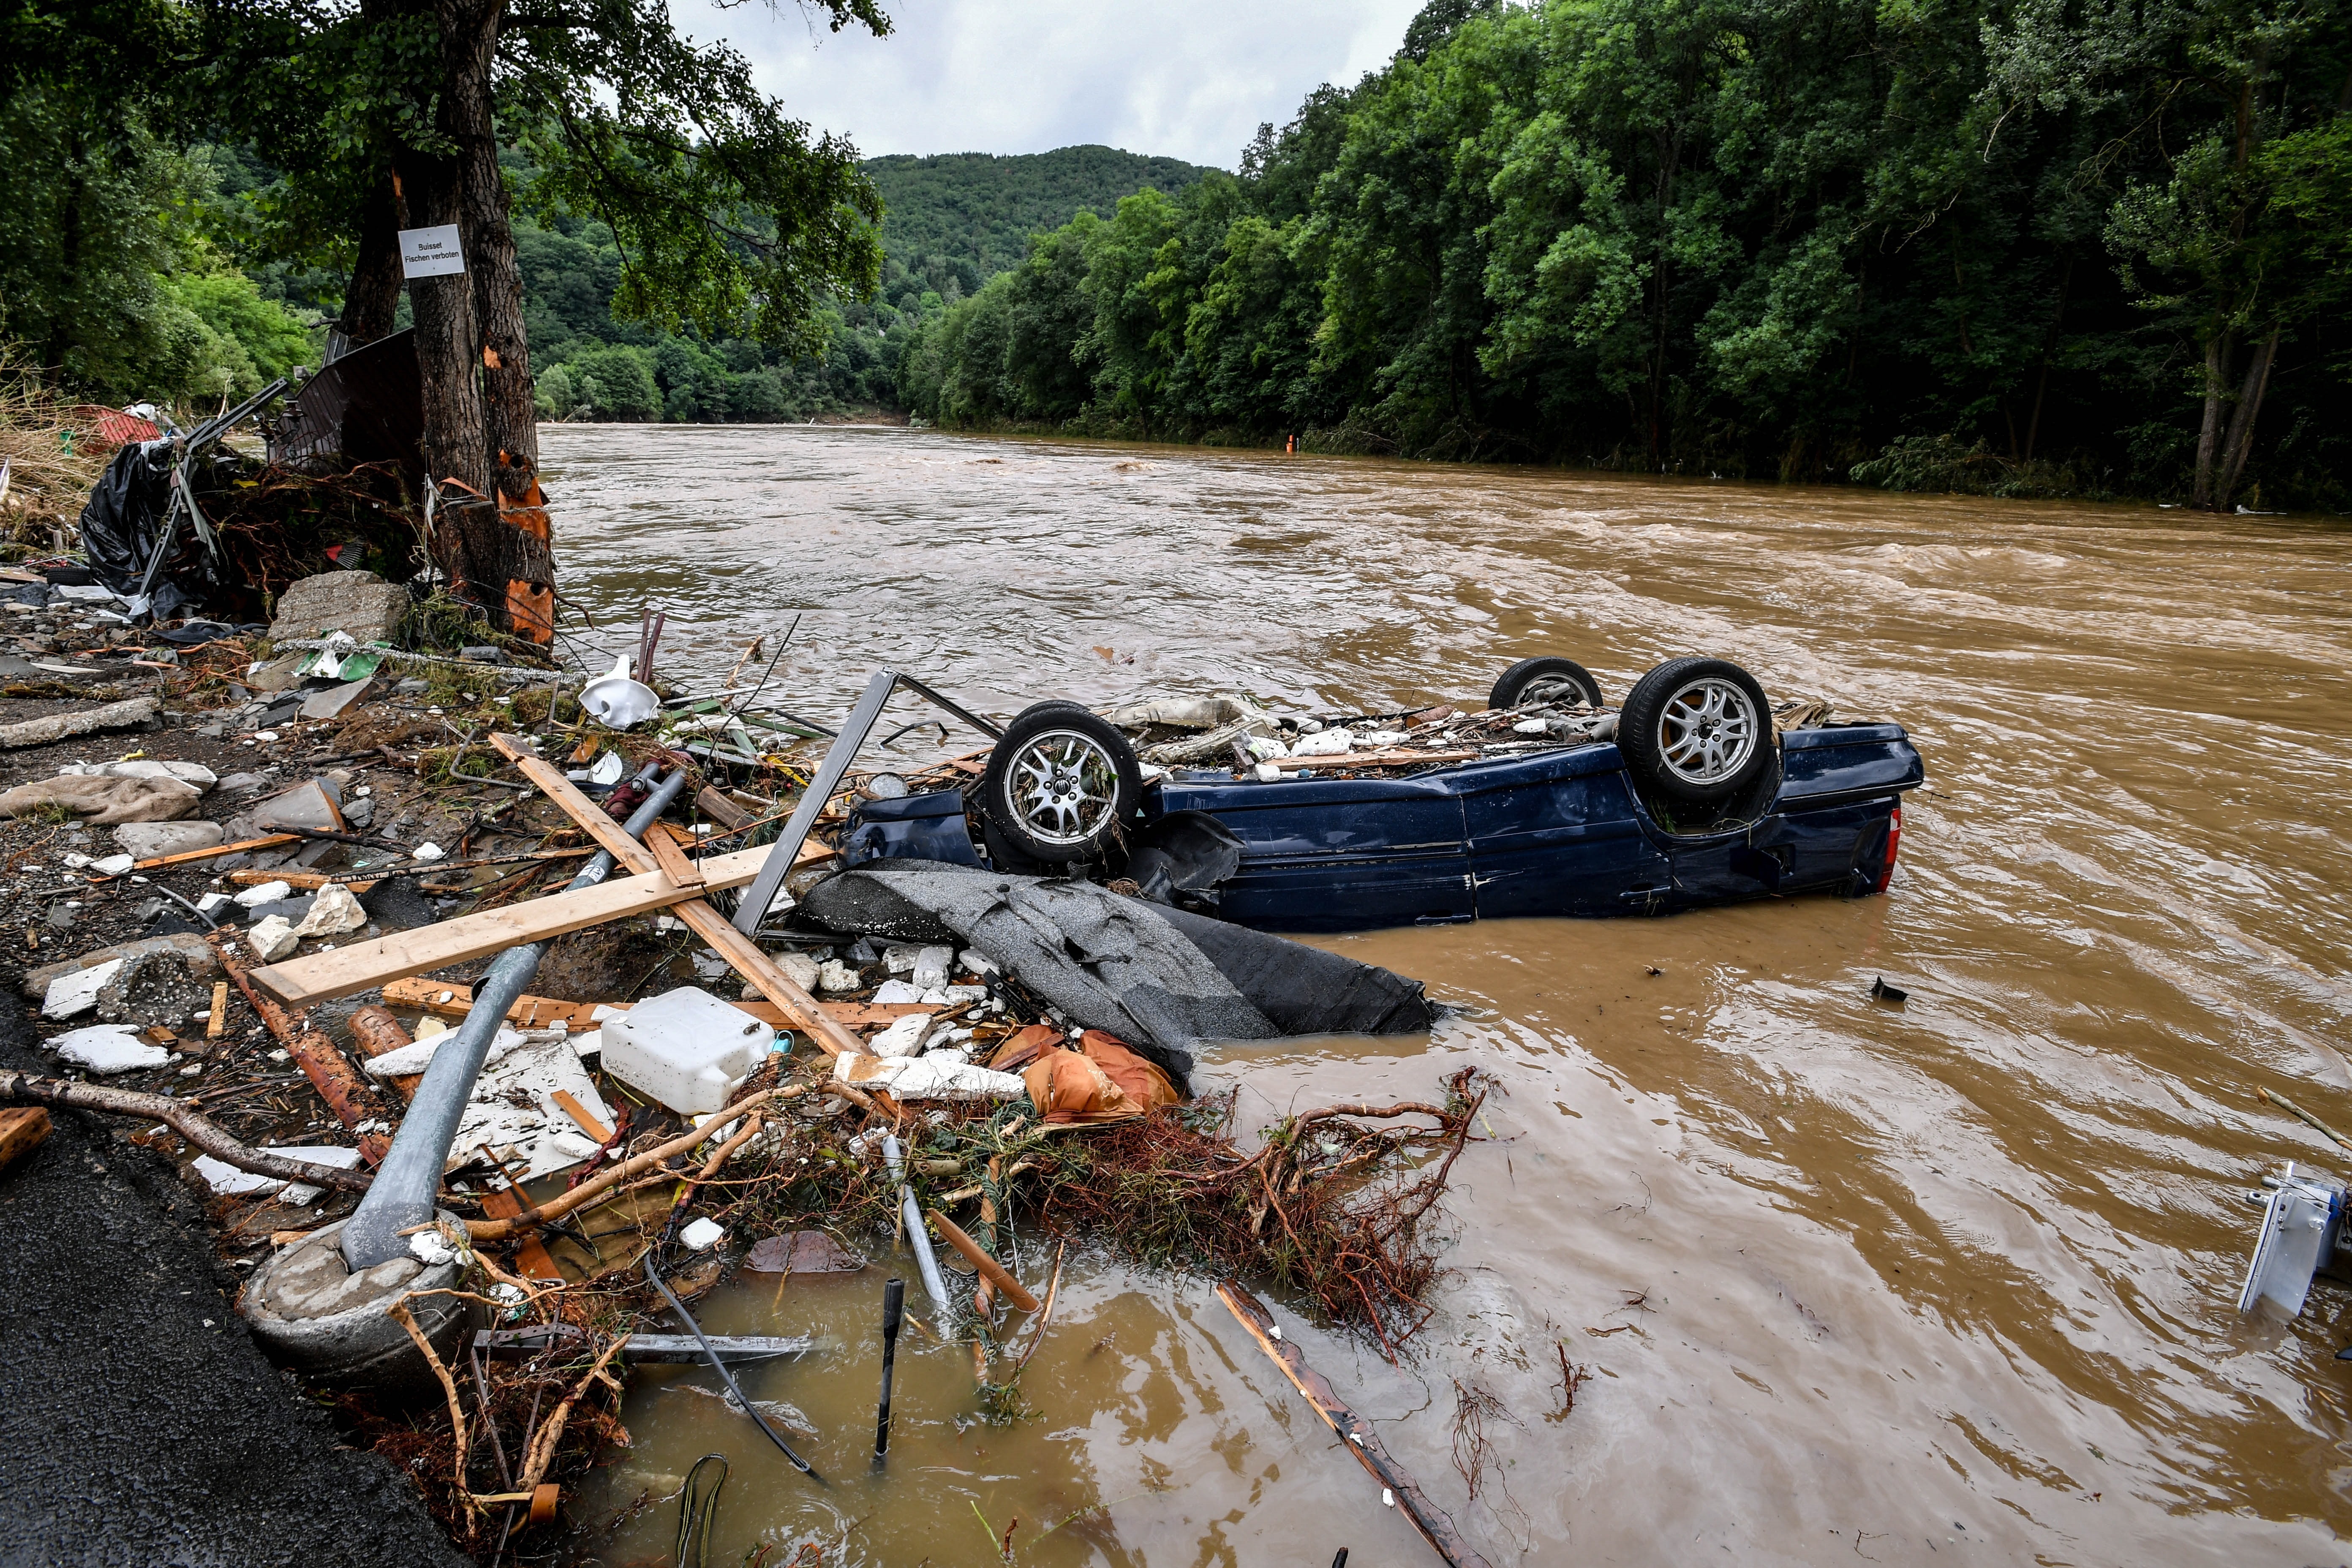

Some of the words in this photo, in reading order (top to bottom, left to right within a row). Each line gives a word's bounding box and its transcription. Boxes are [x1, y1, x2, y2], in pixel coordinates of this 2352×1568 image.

[418, 242, 442, 251] Buisset
[405, 254, 430, 263] Fischen
[431, 251, 459, 260] verboten
